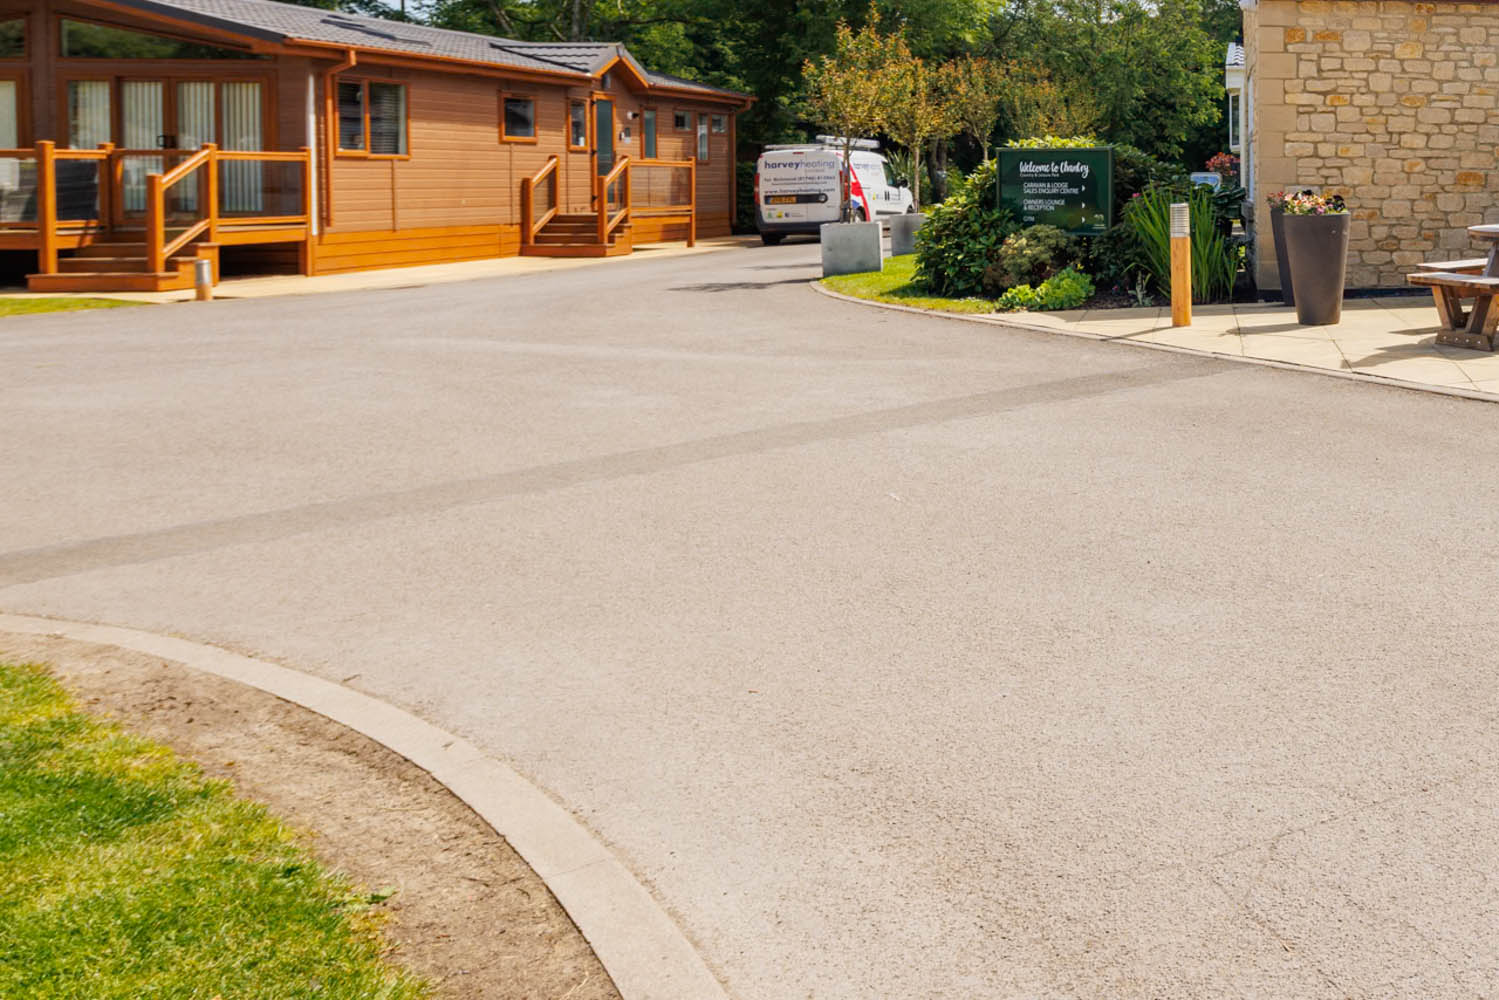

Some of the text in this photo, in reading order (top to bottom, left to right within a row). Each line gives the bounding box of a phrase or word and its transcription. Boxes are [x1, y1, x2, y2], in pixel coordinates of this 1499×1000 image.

[1019, 160, 1089, 179] Welcome to Chantry
